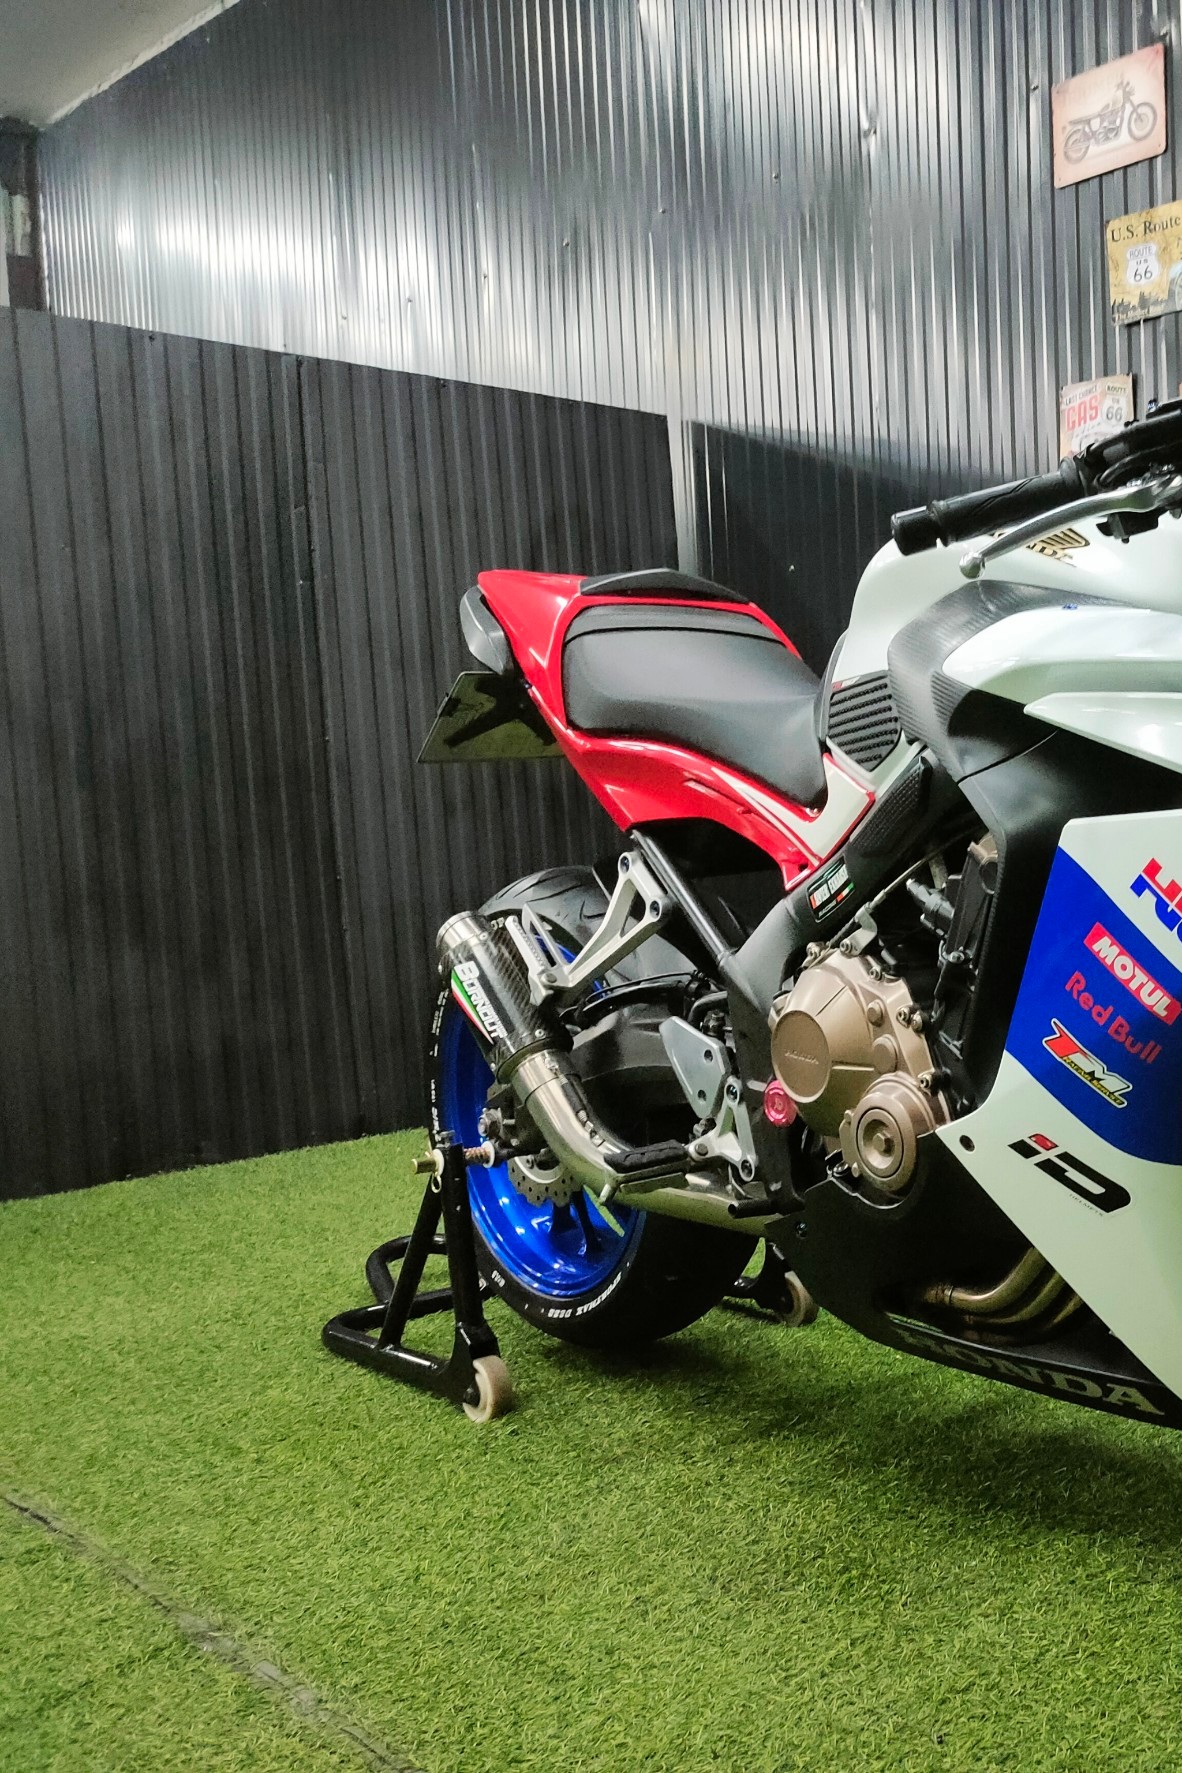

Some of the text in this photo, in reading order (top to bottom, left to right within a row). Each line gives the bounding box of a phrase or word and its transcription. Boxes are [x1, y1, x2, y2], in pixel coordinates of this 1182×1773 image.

[1111, 224, 1139, 242] U.S.
[1143, 215, 1180, 236] Route
[1129, 245, 1153, 258] ROUTE
[1133, 265, 1153, 282] 66
[1107, 384, 1126, 394] ROUTE
[1066, 394, 1099, 432] GAS
[1106, 406, 1122, 421] 66
[1091, 935, 1172, 1018] MOTUL
[1065, 970, 1163, 1064] Red Bull
[898, 1328, 1166, 1416] HONDA
